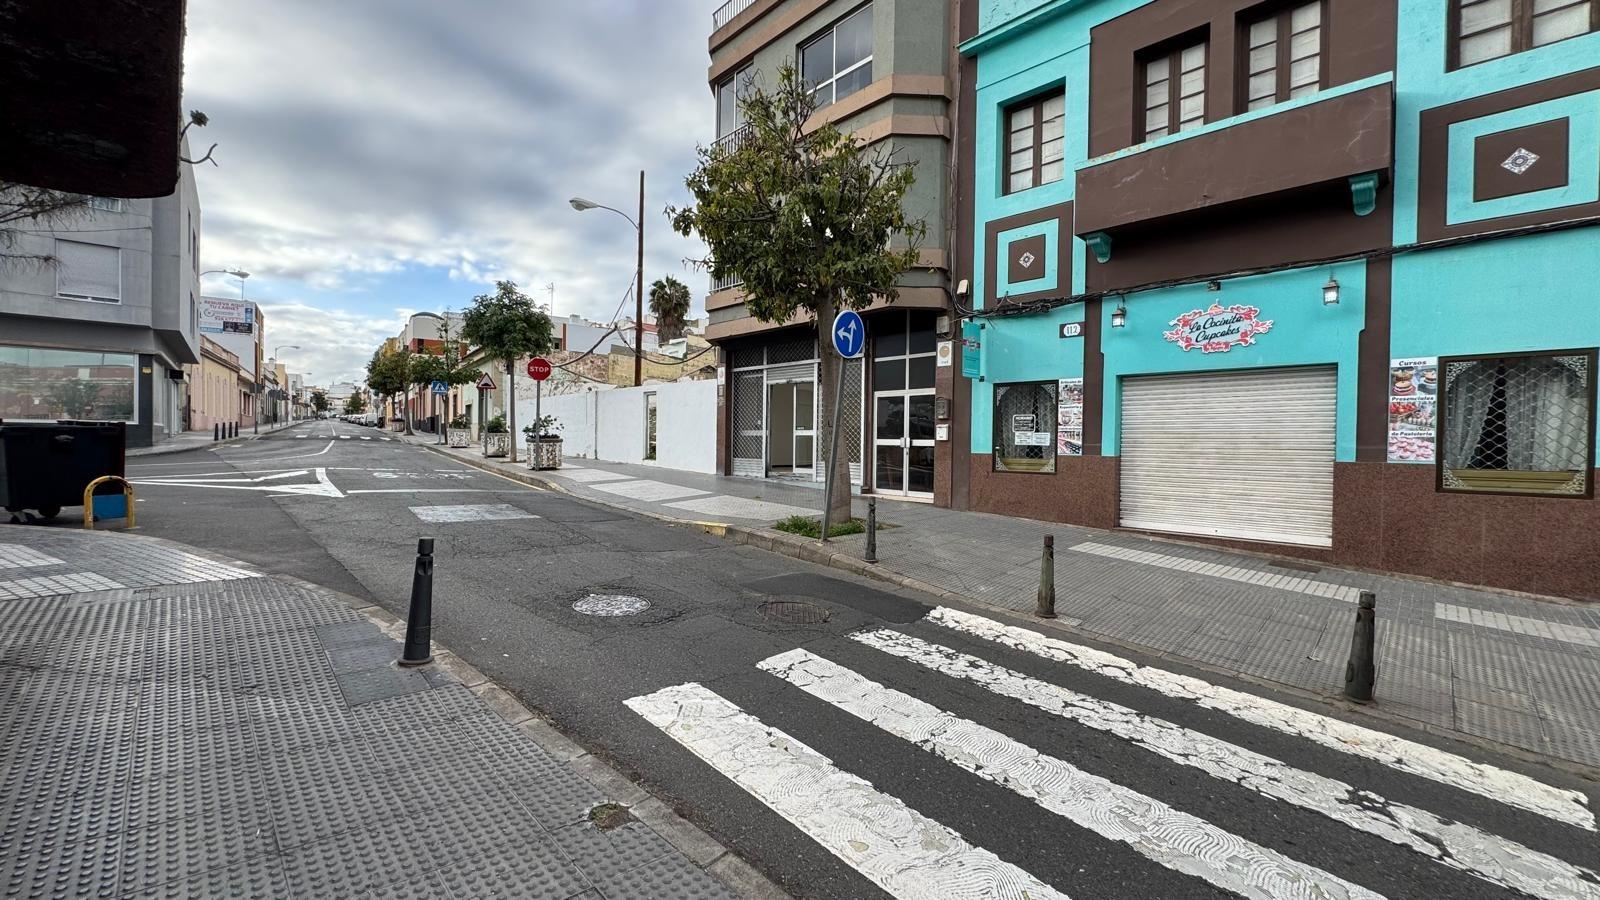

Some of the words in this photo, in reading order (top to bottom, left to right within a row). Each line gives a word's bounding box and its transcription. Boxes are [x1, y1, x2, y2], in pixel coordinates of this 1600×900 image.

[1066, 325, 1078, 335] 112
[1189, 321, 1202, 334] La
[1203, 313, 1245, 330] Cocinita
[1195, 325, 1240, 344] Cupcakes
